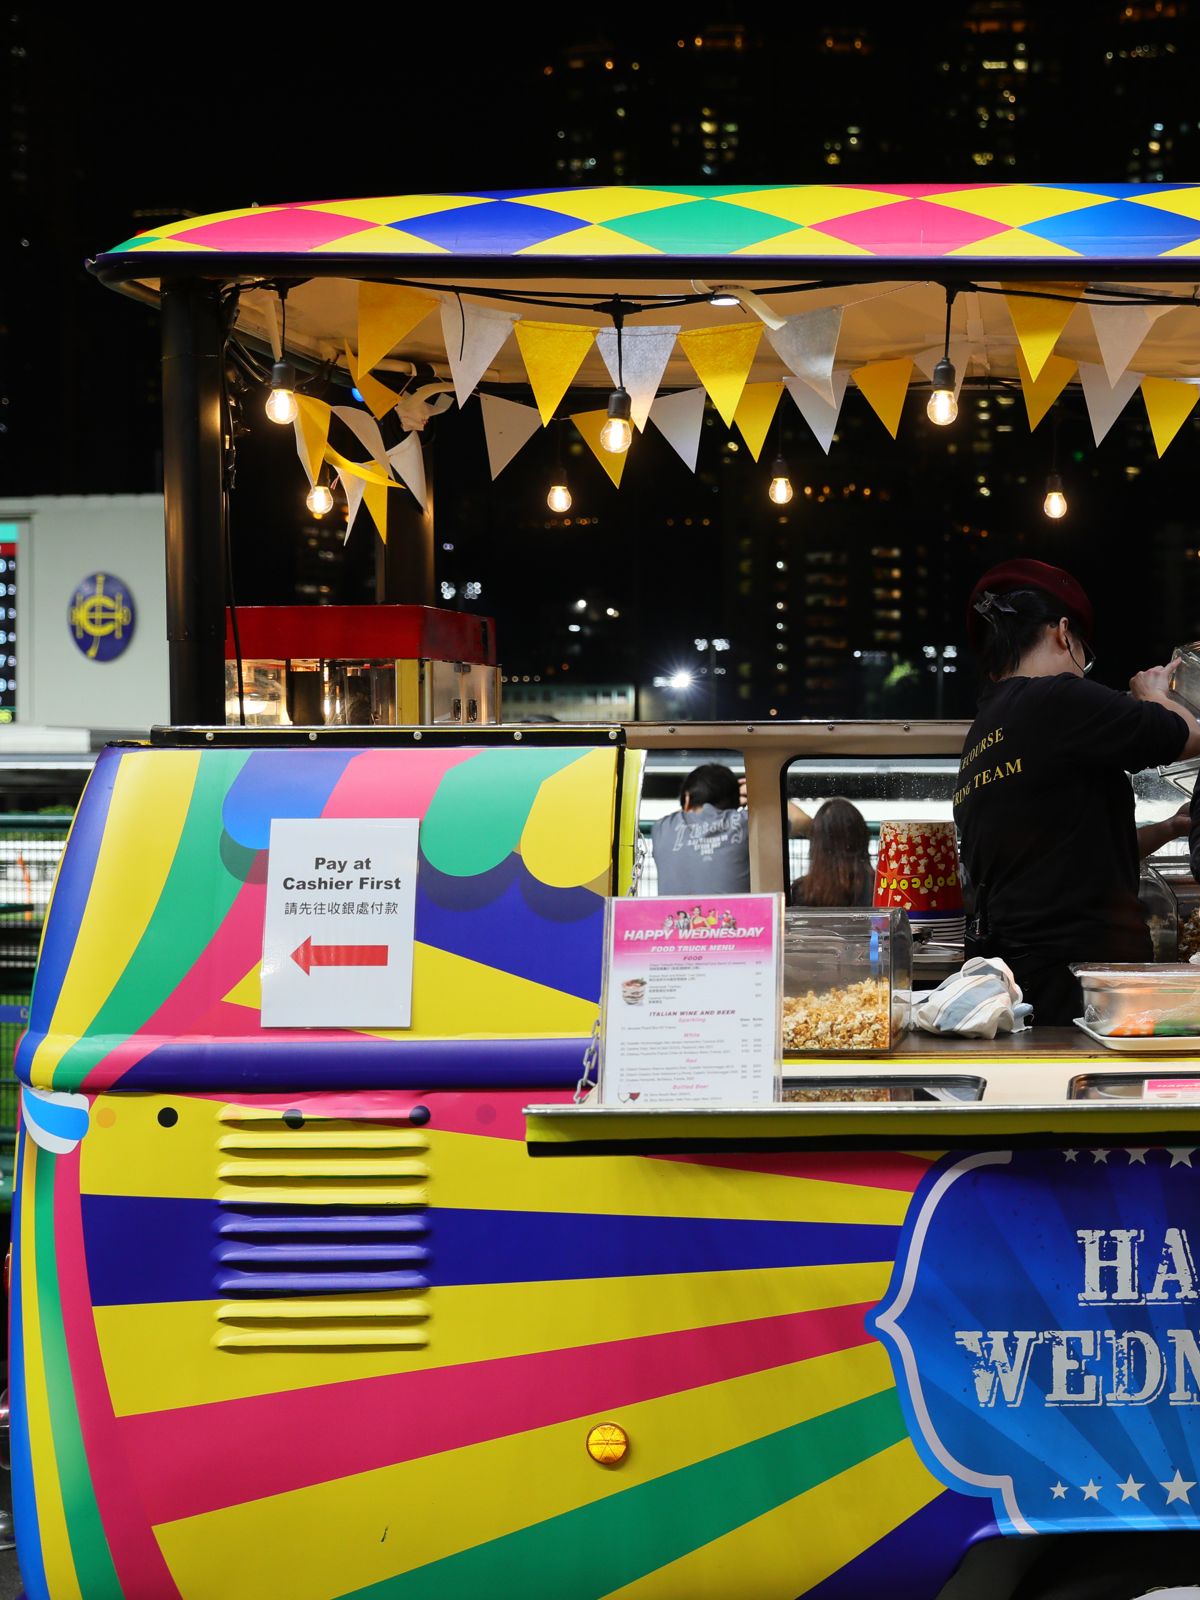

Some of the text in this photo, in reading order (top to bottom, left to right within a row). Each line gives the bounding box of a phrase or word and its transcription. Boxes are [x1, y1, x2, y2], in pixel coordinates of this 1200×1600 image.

[974, 758, 1023, 789] TEAM
[314, 857, 371, 873] Pay at
[282, 877, 401, 890] Cashier First
[284, 901, 399, 915] 請先往收銀處付款
[624, 927, 765, 941] HAPPY WEDNESDAY
[651, 944, 736, 953] FOOD TRUCK MENU
